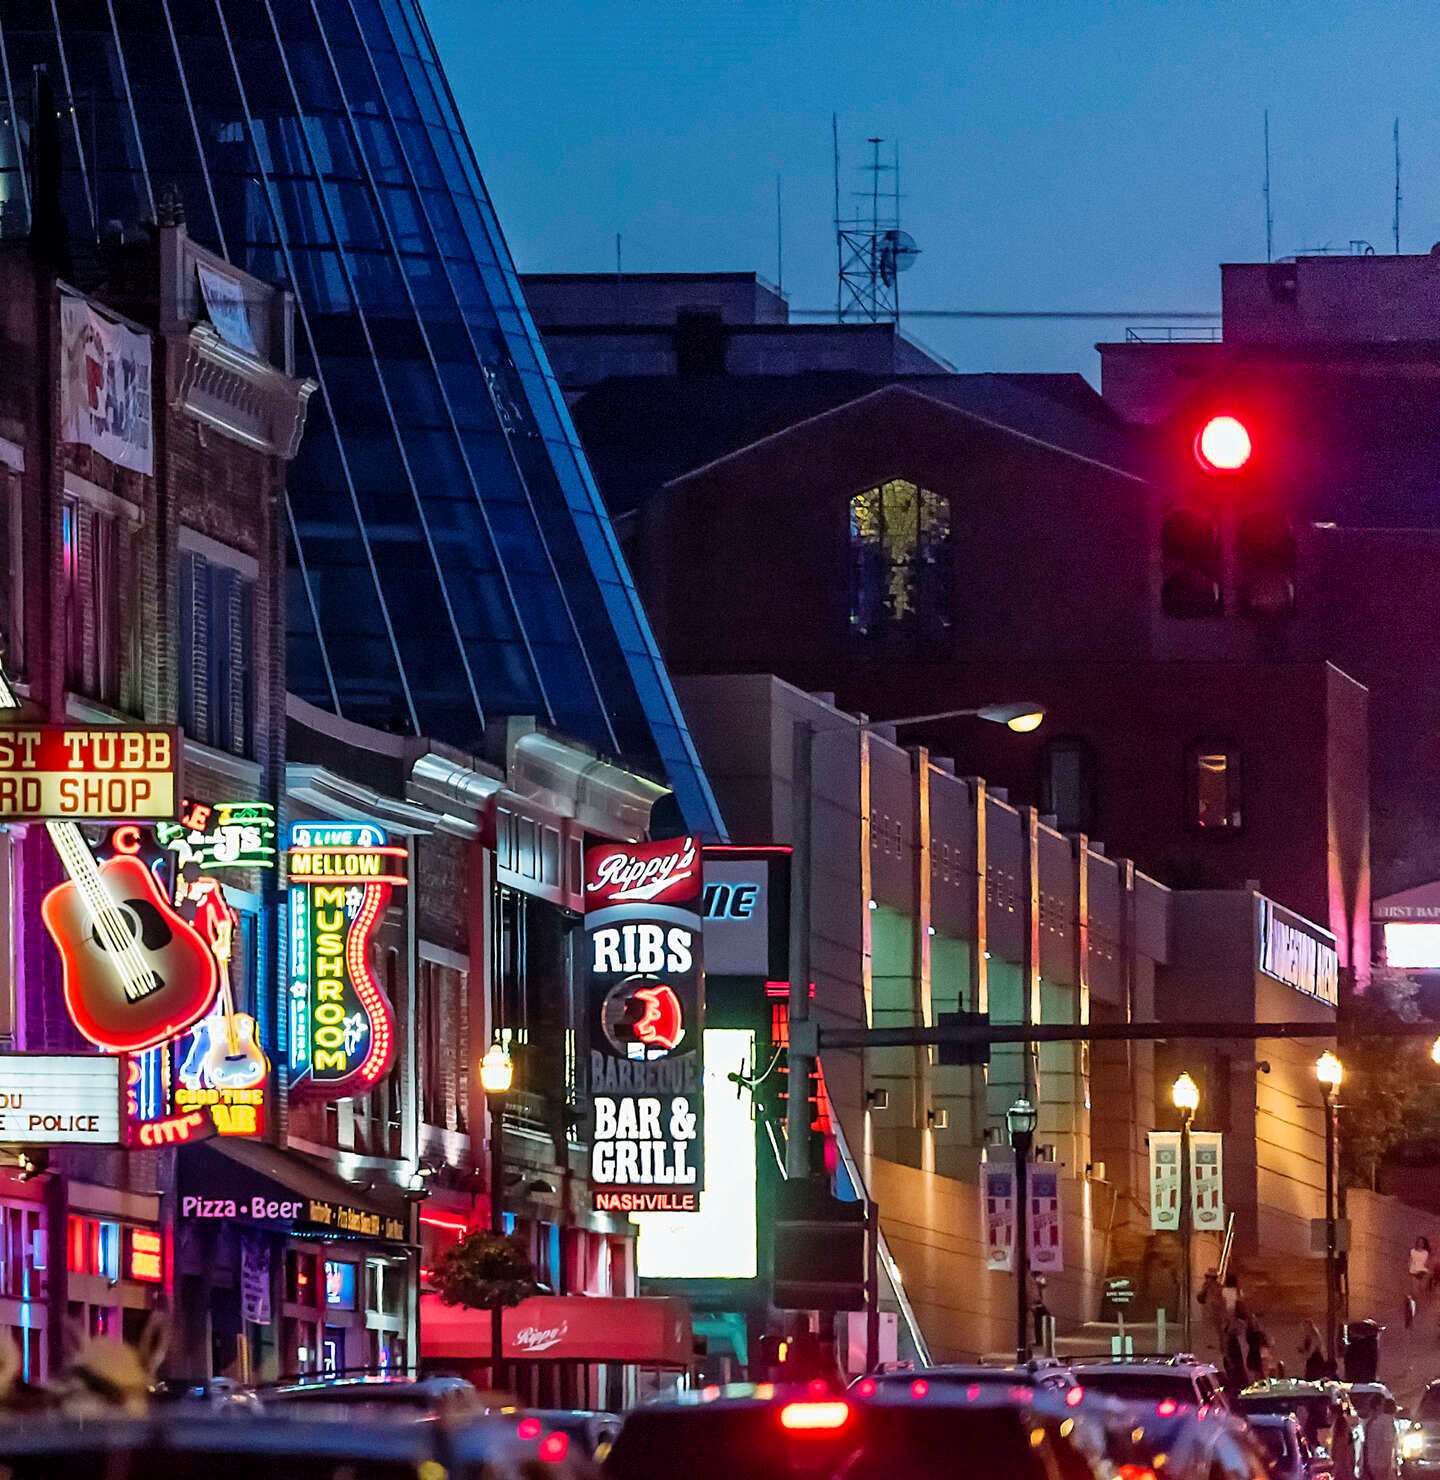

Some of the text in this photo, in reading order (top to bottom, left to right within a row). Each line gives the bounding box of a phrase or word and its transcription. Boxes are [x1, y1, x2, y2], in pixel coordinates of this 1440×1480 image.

[63, 731, 171, 769] TUBB
[60, 778, 152, 813] SHOP
[313, 831, 353, 846] LIVE
[291, 854, 381, 875] MELLOW
[586, 837, 696, 894] Rippy's
[703, 884, 759, 919] NE
[592, 924, 693, 974] RIBS
[314, 886, 347, 1072] MUSHROOM
[28, 1115, 99, 1132] POLICE
[140, 1112, 203, 1146] CITY
[594, 1096, 697, 1141] BAR &
[592, 1141, 697, 1184] GRILL
[182, 1196, 237, 1218] Pizza
[251, 1196, 303, 1219] Beer
[596, 1193, 695, 1211] NASHVILLE
